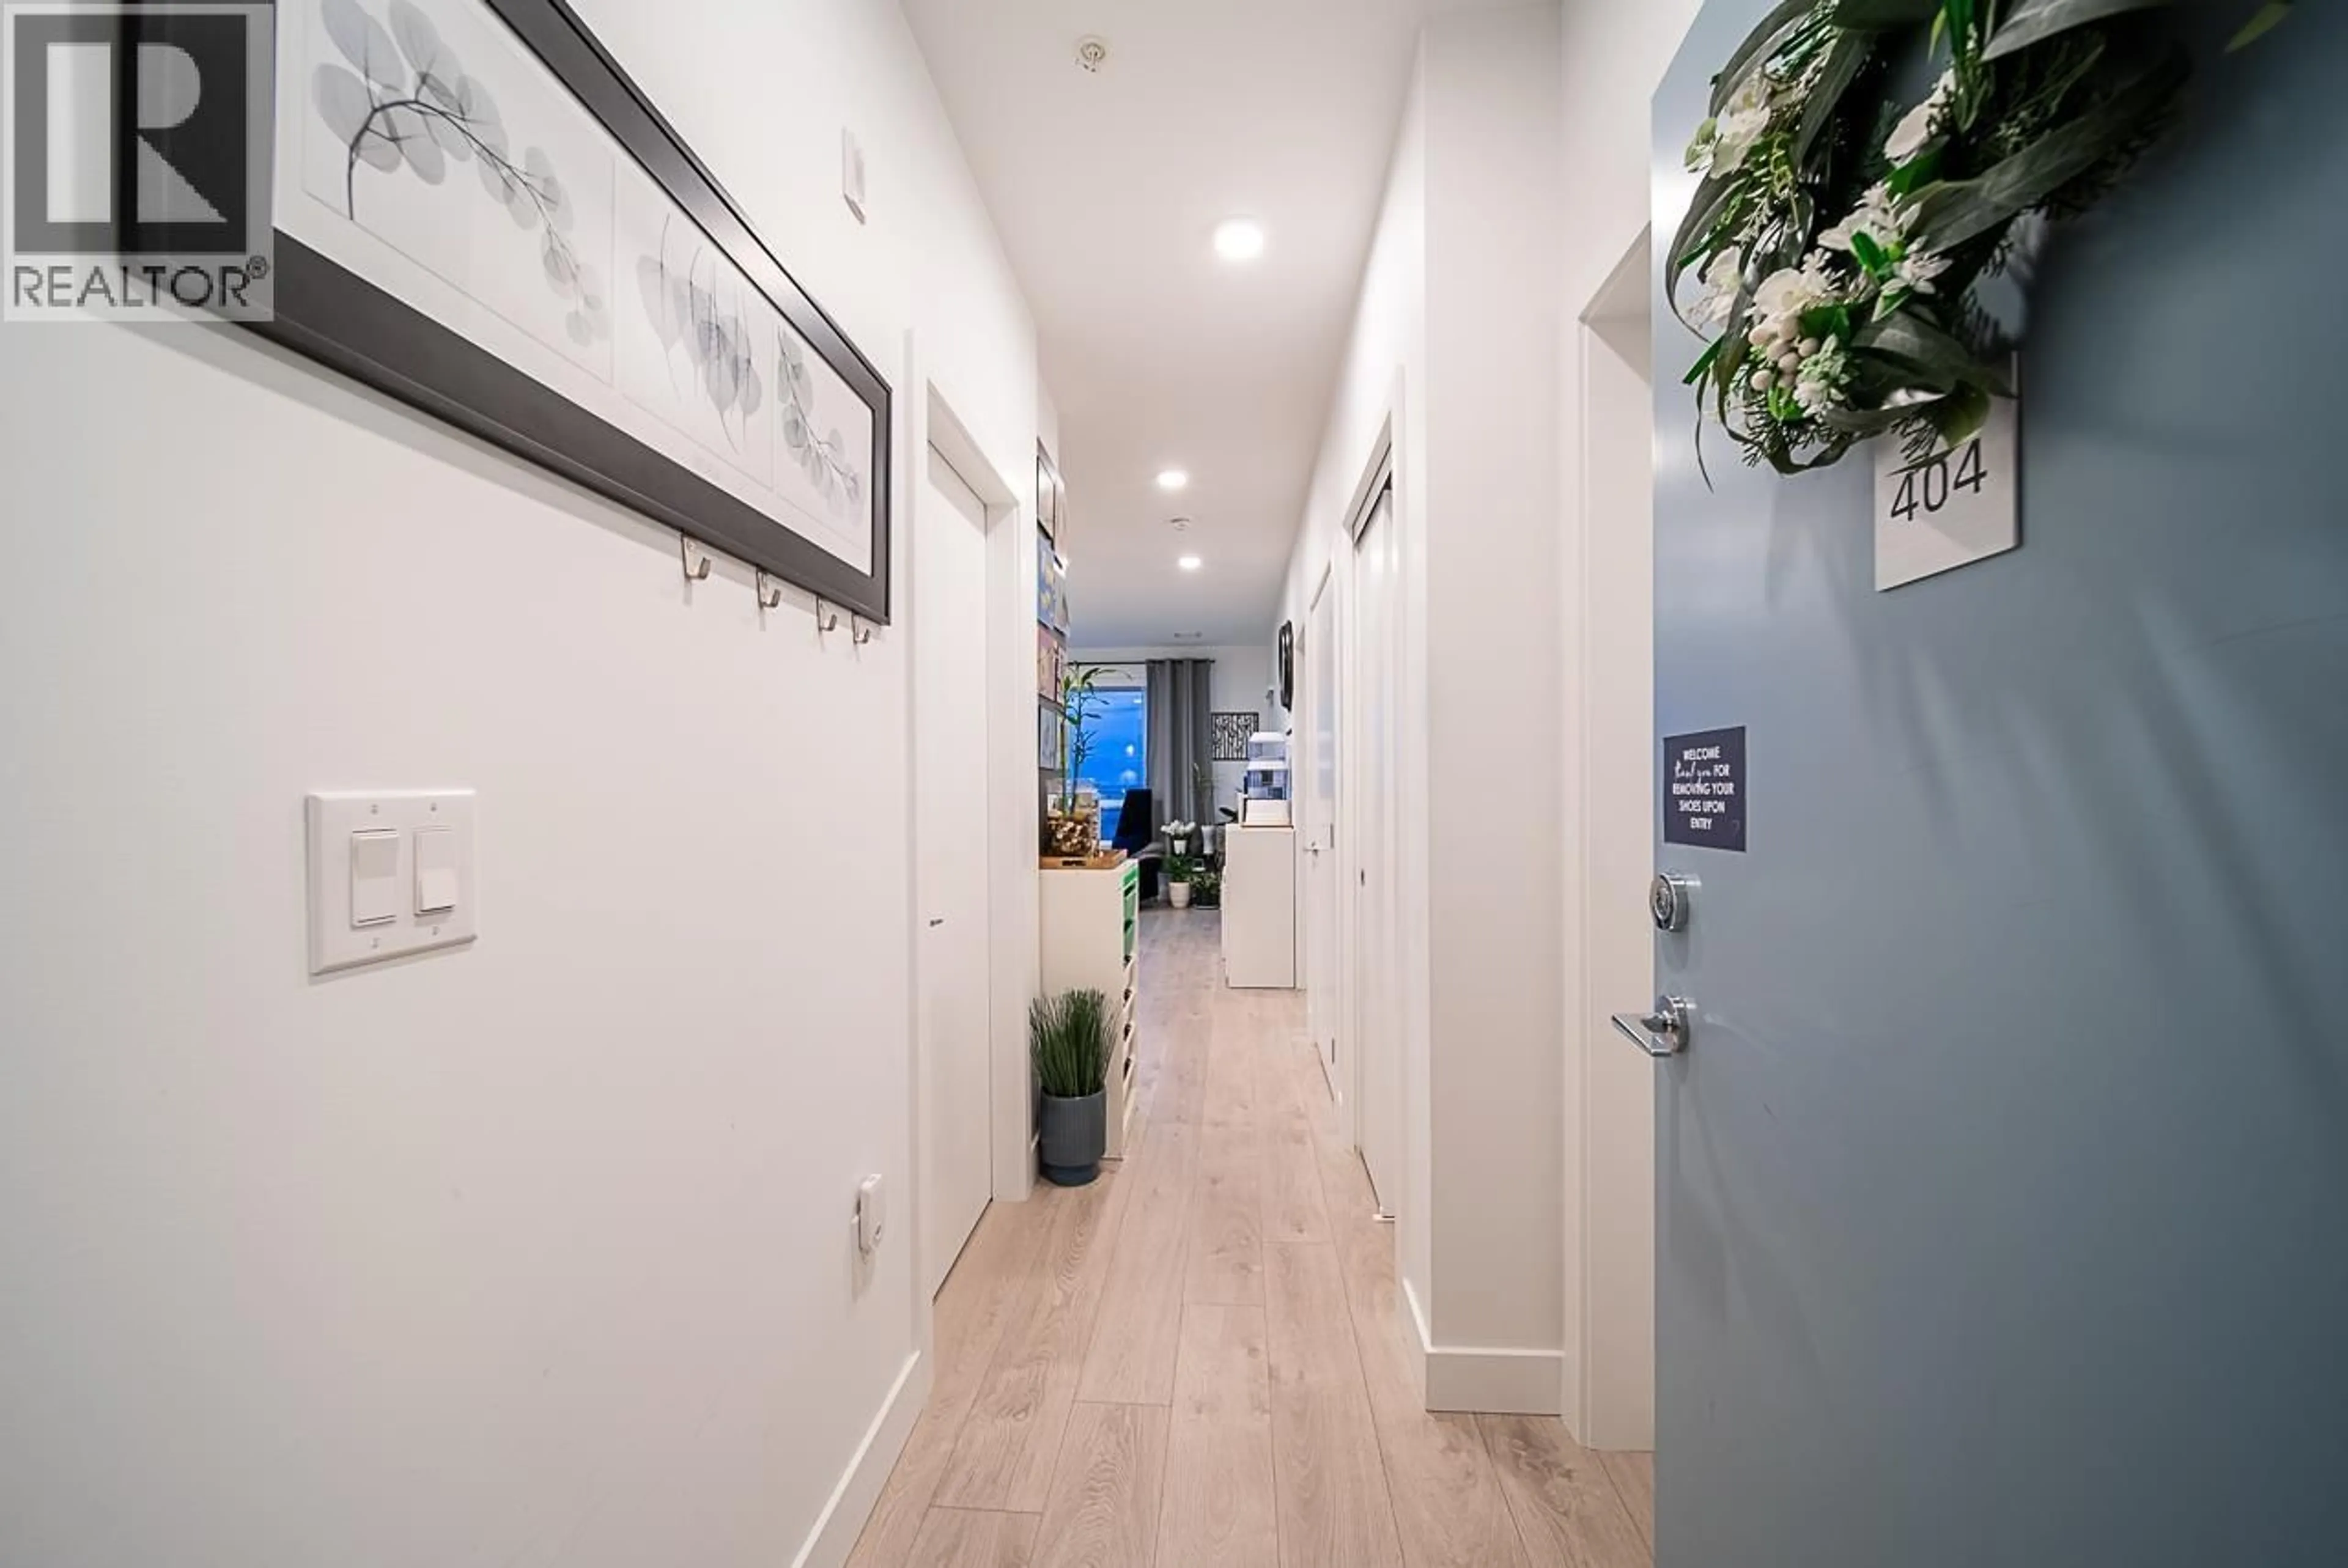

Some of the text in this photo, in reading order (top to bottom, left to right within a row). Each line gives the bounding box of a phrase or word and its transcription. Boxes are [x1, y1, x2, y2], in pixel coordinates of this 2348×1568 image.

[1891, 438, 1988, 521] 404
[1683, 746, 1721, 760] WELCOME
[1713, 764, 1730, 777] FOR
[1672, 782, 1734, 795] REMOVING YOUR
[1678, 800, 1725, 814] SHOES UPON
[1690, 817, 1712, 830] ENTRY
